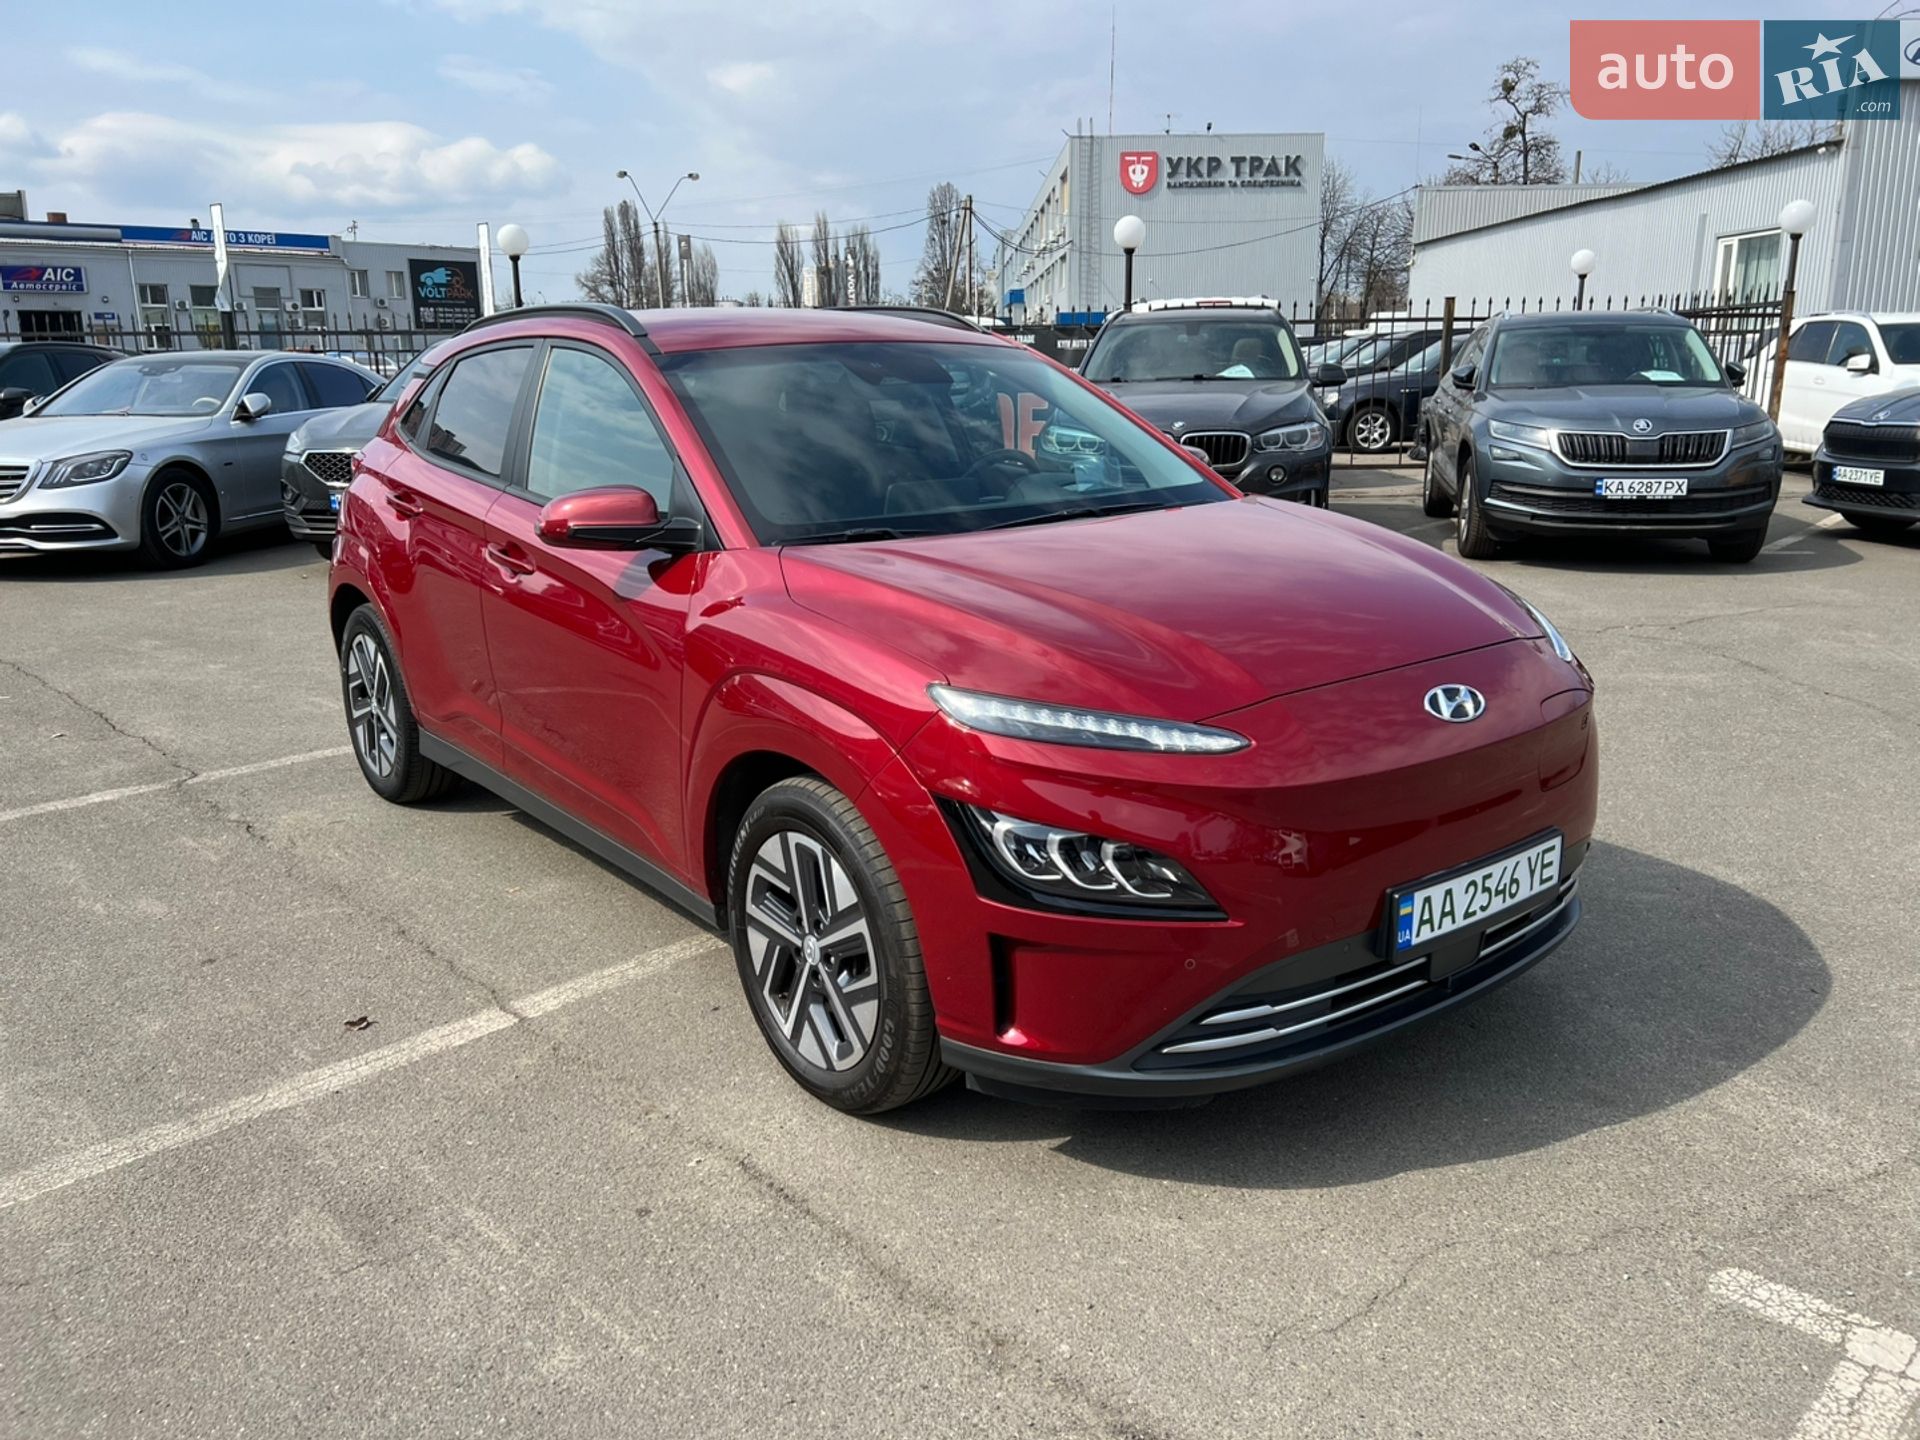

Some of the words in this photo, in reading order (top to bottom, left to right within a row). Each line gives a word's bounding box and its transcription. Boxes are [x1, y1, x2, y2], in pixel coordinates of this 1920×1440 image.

[1166, 156, 1222, 179] УКР
[1230, 155, 1302, 178] ТРАК
[1604, 481, 1625, 494] KA
[1628, 481, 1663, 494] 6287
[1663, 481, 1686, 494] PX
[1415, 888, 1456, 938] AA
[1462, 860, 1521, 921] 2546
[1527, 845, 1556, 891] YE
[1397, 932, 1412, 944] UA
